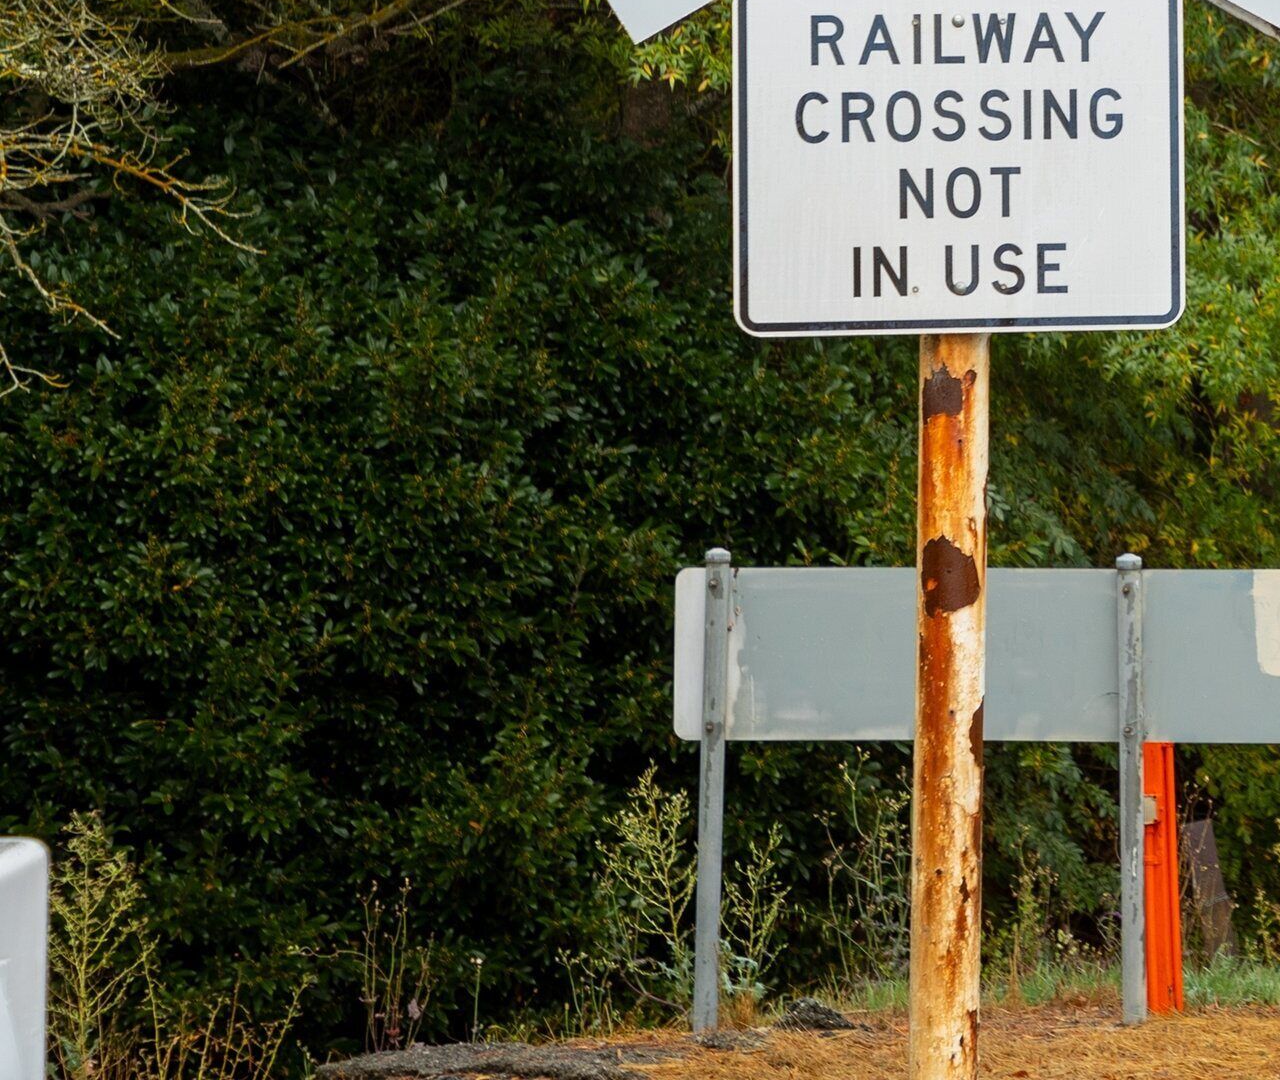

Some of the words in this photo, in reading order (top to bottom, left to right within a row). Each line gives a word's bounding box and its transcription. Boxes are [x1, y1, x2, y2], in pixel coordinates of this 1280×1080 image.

[811, 12, 1106, 66] RAILWAY
[795, 88, 1123, 144] CROSSING
[899, 167, 1021, 219] NOT
[853, 246, 908, 298] IN
[945, 243, 1068, 296] USE
